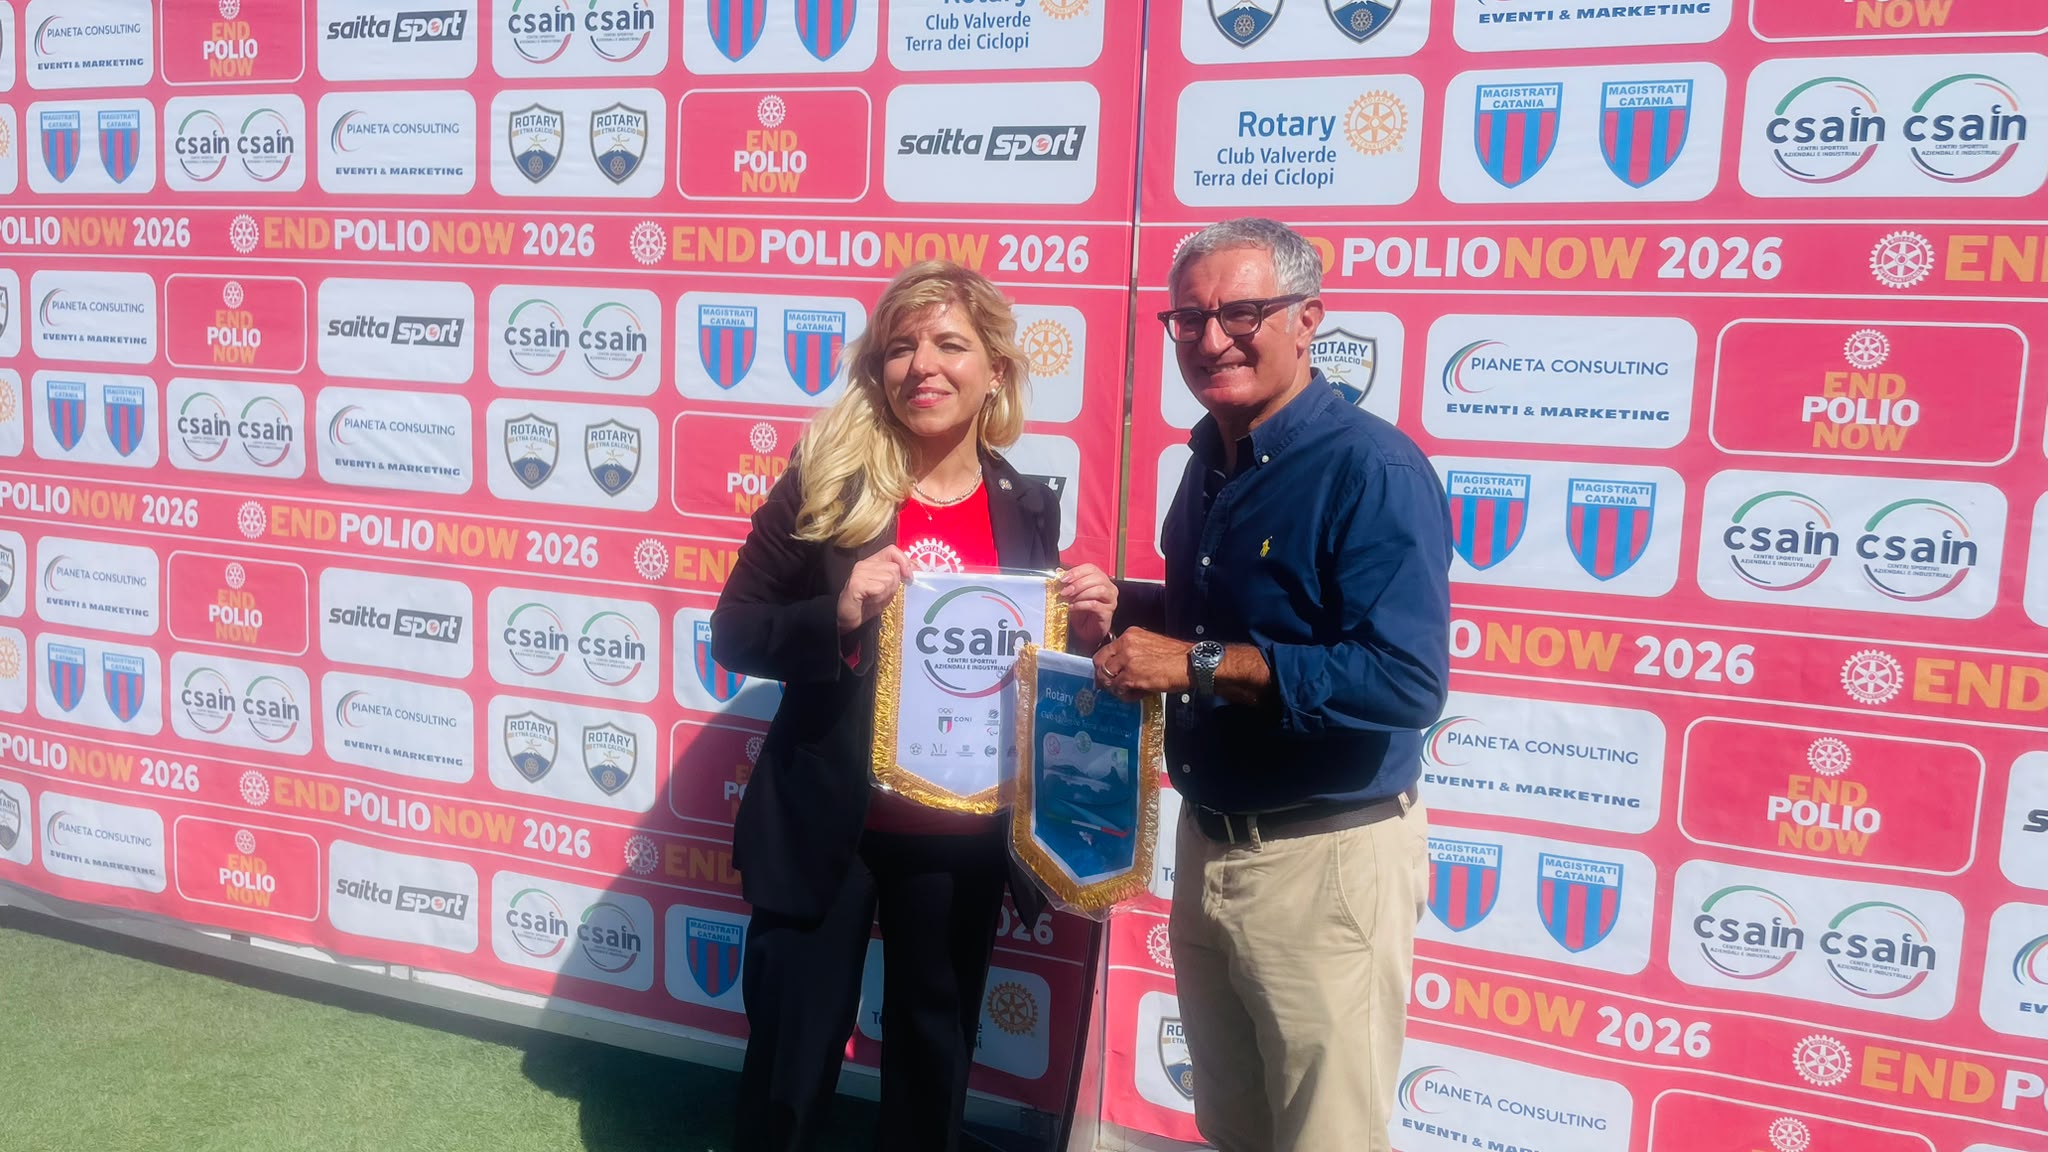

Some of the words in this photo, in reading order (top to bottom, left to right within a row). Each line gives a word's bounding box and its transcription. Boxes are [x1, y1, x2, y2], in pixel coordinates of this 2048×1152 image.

[508, 5, 575, 33] csain
[585, 2, 654, 31] csain
[926, 13, 958, 30] Club
[964, 11, 1030, 28] Valverde
[1479, 11, 1553, 23] EVENTI
[1559, 10, 1570, 20] &
[1577, 3, 1710, 19] MARKETING
[1855, 0, 1951, 29] NOW
[47, 27, 83, 37] PIANETA
[85, 24, 140, 35] CONSULTING
[212, 22, 249, 39] END
[327, 15, 390, 39] saitta
[399, 13, 462, 42] sport
[203, 38, 257, 60] POLIO
[906, 37, 941, 51] Terra
[948, 34, 970, 50] dei
[977, 32, 1028, 52] Ciclopi
[38, 62, 72, 70] EVENTI
[83, 59, 143, 67] MARKETING
[210, 59, 253, 76] NOW
[1483, 87, 1556, 98] MAGISTRATI
[1608, 85, 1687, 96] MAGISTRATI
[1619, 96, 1673, 107] CATANIA
[1493, 98, 1544, 109] CATANIA
[347, 124, 390, 134] PIANETA
[393, 123, 459, 134] CONSULTING
[515, 115, 557, 128] ROTARY
[597, 114, 641, 128] ROTARY
[1239, 111, 1336, 141] Rotary
[1766, 106, 1886, 144] csain
[1903, 104, 2027, 142] csain
[175, 130, 229, 155] csain
[237, 130, 293, 154] csain
[747, 130, 797, 151] END
[898, 129, 983, 154] saitta
[993, 129, 1079, 160] sport
[734, 151, 807, 174] POLIO
[1218, 147, 1254, 164] Club
[1261, 146, 1336, 163] Valverde
[742, 173, 801, 193] NOW
[1194, 171, 1234, 186] Terra
[1242, 169, 1267, 185] dei
[1275, 168, 1333, 189] Ciclopi
[133, 217, 190, 247] 2026
[523, 223, 594, 256] 2026
[999, 234, 1088, 273] 2026
[1658, 237, 1782, 279] 2026
[52, 301, 87, 310] PIANETA
[90, 302, 144, 313] CONSULTING
[702, 308, 753, 318] MAGISTRATI
[789, 313, 841, 323] MAGISTRATI
[216, 311, 253, 327] END
[328, 316, 389, 338] saitta
[710, 317, 745, 327] CATANIA
[796, 322, 833, 332] CATANIA
[43, 333, 76, 341] EVENTI
[87, 335, 147, 344] MARKETING
[207, 326, 261, 348] POLIO
[397, 320, 459, 345] sport
[504, 322, 569, 349] csain
[578, 325, 646, 352] csain
[214, 346, 256, 364] NOW
[1310, 341, 1368, 357] ROTARY
[1313, 355, 1333, 364] ETNA
[1334, 356, 1360, 365] CALCIO
[1472, 358, 1545, 371] PIANETA
[1551, 360, 1668, 375] CONSULTING
[1824, 371, 1906, 399] END
[1447, 404, 1518, 415] EVENTI
[1524, 407, 1534, 415] &
[1541, 407, 1669, 421] MARKETING
[1802, 396, 1919, 426] POLIO
[345, 418, 386, 430] PIANETA
[390, 422, 455, 436] CONSULTING
[510, 424, 552, 438] ROTARY
[591, 430, 634, 444] ROTARY
[1813, 422, 1909, 451] NOW
[335, 458, 375, 468] EVENTI
[388, 463, 460, 475] MARKETING
[1454, 475, 1524, 487] MAGISTRATI
[1463, 486, 1512, 497] CATANIA
[1575, 483, 1649, 495] MAGISTRATI
[1585, 494, 1637, 505] CATANIA
[142, 495, 198, 528] 2026
[527, 531, 598, 568] 2026
[1723, 521, 1839, 556] csain
[1856, 530, 1977, 565] csain
[921, 545, 945, 556] ROTARY
[916, 619, 1032, 656] csain
[1634, 636, 1755, 684] 2026
[1046, 688, 1073, 705] Rotary
[588, 732, 631, 748] ROTARY
[1448, 732, 1519, 751] PIANETA
[1525, 741, 1638, 764] CONSULTING
[140, 758, 199, 792] 2026
[1425, 774, 1493, 789] EVENTI
[1499, 783, 1509, 791] &
[1516, 784, 1640, 808] MARKETING
[1788, 774, 1868, 808] END
[1767, 795, 1881, 833] POLIO
[523, 819, 590, 858] 2026
[1428, 841, 1497, 856] MAGISTRATI
[1778, 821, 1870, 857] NOW
[228, 854, 266, 872] END
[1438, 852, 1486, 865] CATANIA
[1545, 858, 1617, 876] MAGISTRATI
[219, 868, 275, 893] POLIO
[1555, 869, 1605, 885] CATANIA
[227, 886, 270, 908] NOW
[336, 879, 392, 904] saitta
[402, 893, 464, 918] sport
[506, 911, 568, 938] csain
[1694, 916, 1804, 951] csain
[1820, 933, 1936, 971] csain
[1597, 1006, 1712, 1058] 2026
[1425, 1080, 1492, 1108] PIANETA
[1498, 1099, 1606, 1130] CONSULTING
[1403, 1118, 1467, 1143] EVENTI
[1472, 1138, 1482, 1147] &
